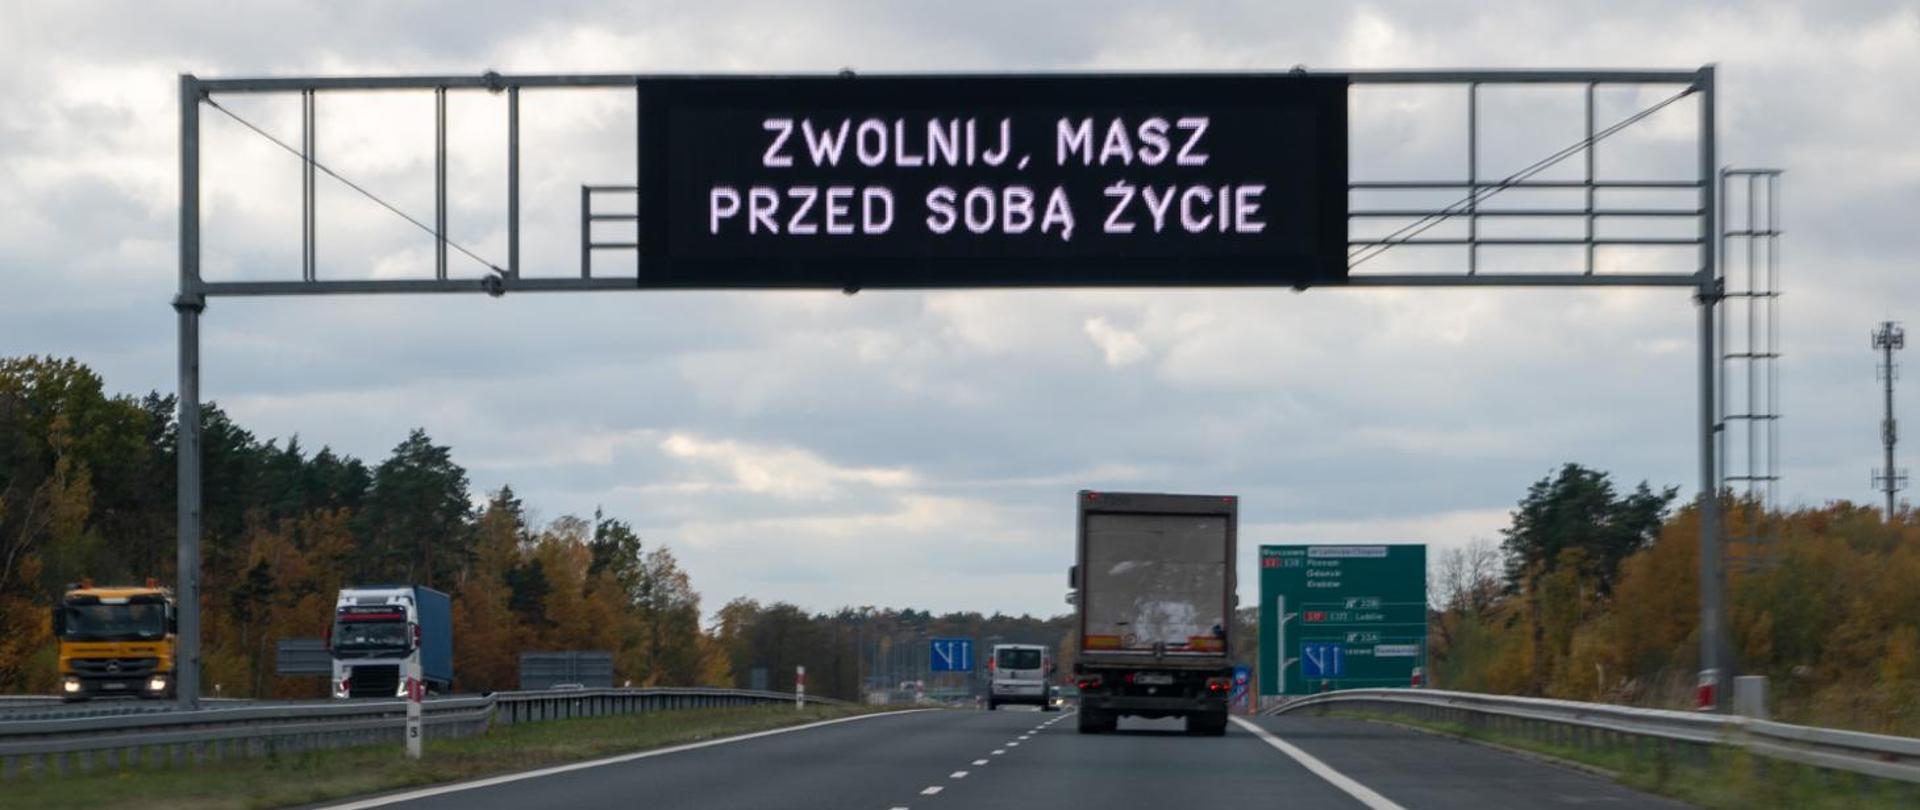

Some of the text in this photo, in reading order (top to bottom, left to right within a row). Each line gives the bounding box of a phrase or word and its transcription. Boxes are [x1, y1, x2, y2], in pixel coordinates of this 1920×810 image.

[762, 117, 1210, 169] ZWOLNIJ, MASZ
[709, 186, 895, 235] PRZED
[925, 184, 1075, 241] SOBĄ
